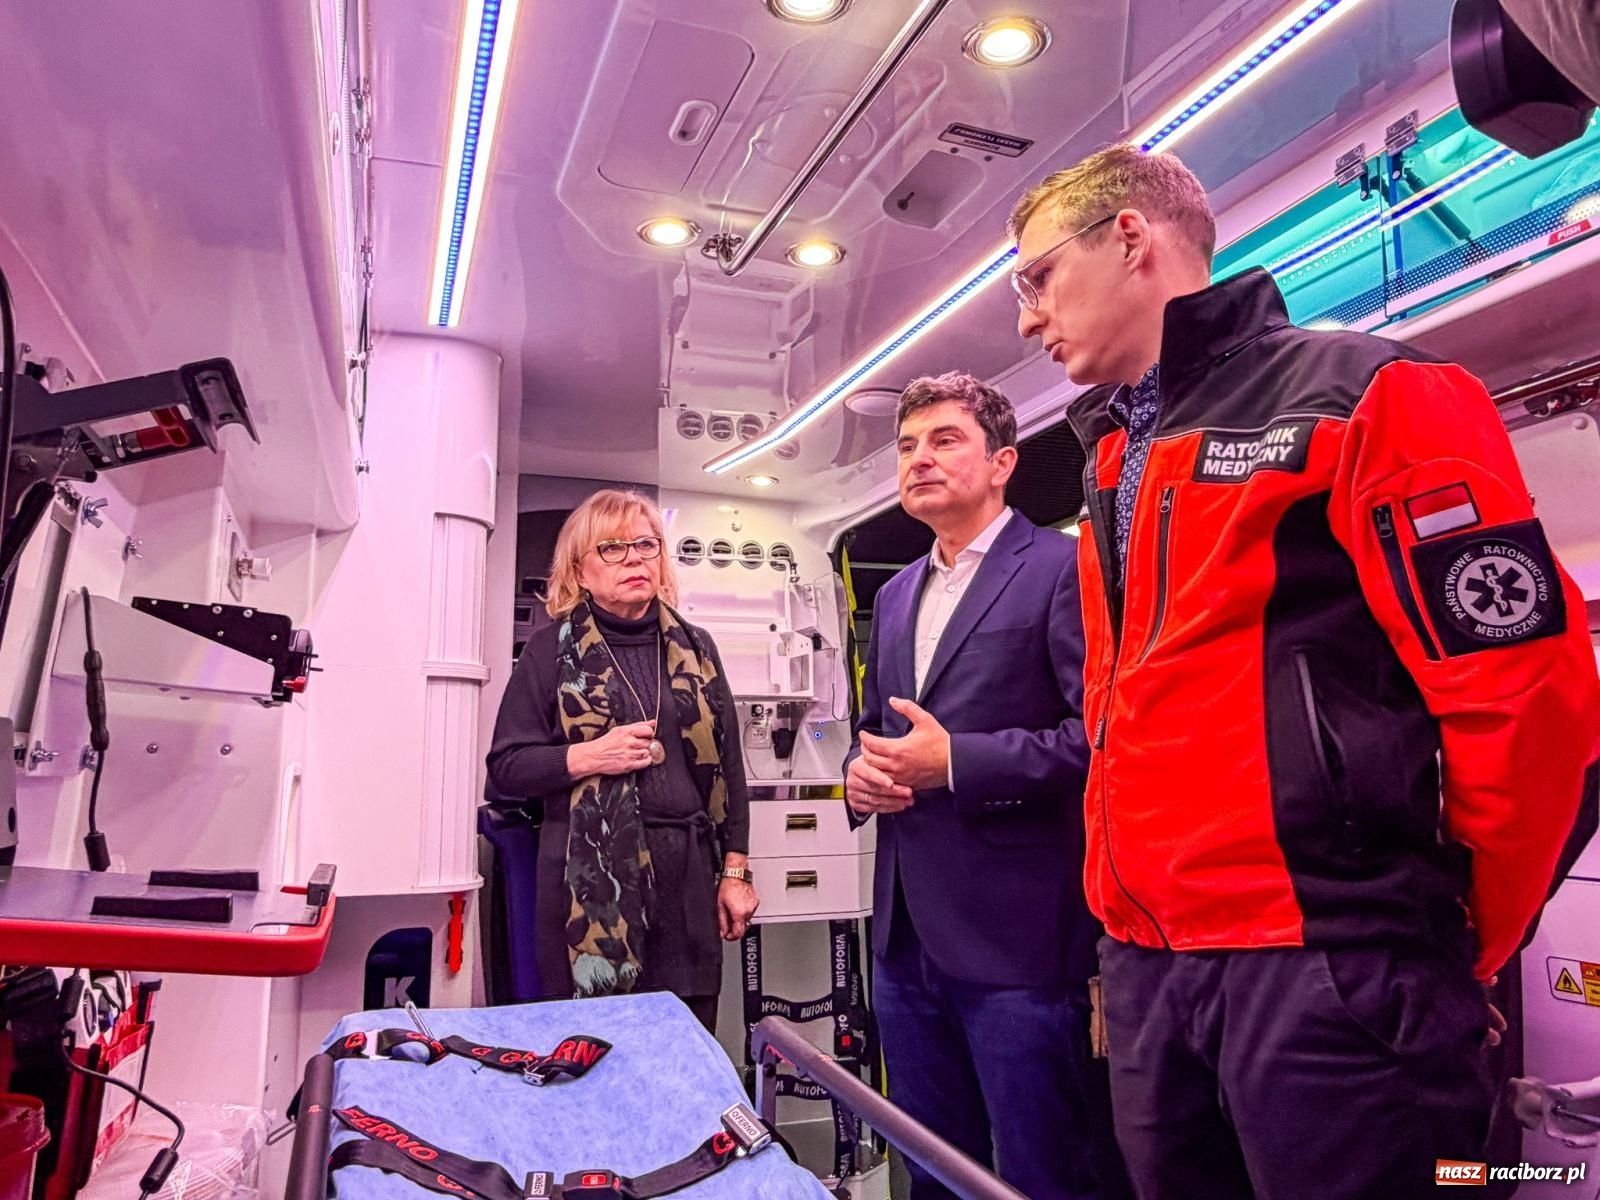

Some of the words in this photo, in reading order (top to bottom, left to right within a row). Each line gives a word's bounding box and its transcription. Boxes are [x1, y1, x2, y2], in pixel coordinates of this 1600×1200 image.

[1557, 225, 1582, 241] PUSH
[1207, 426, 1299, 458] RATONIK
[1445, 552, 1474, 620] PAŃSTWOWE
[1483, 545, 1548, 602] RATOWNICTWO
[1474, 610, 1542, 638] MEDYCZNE
